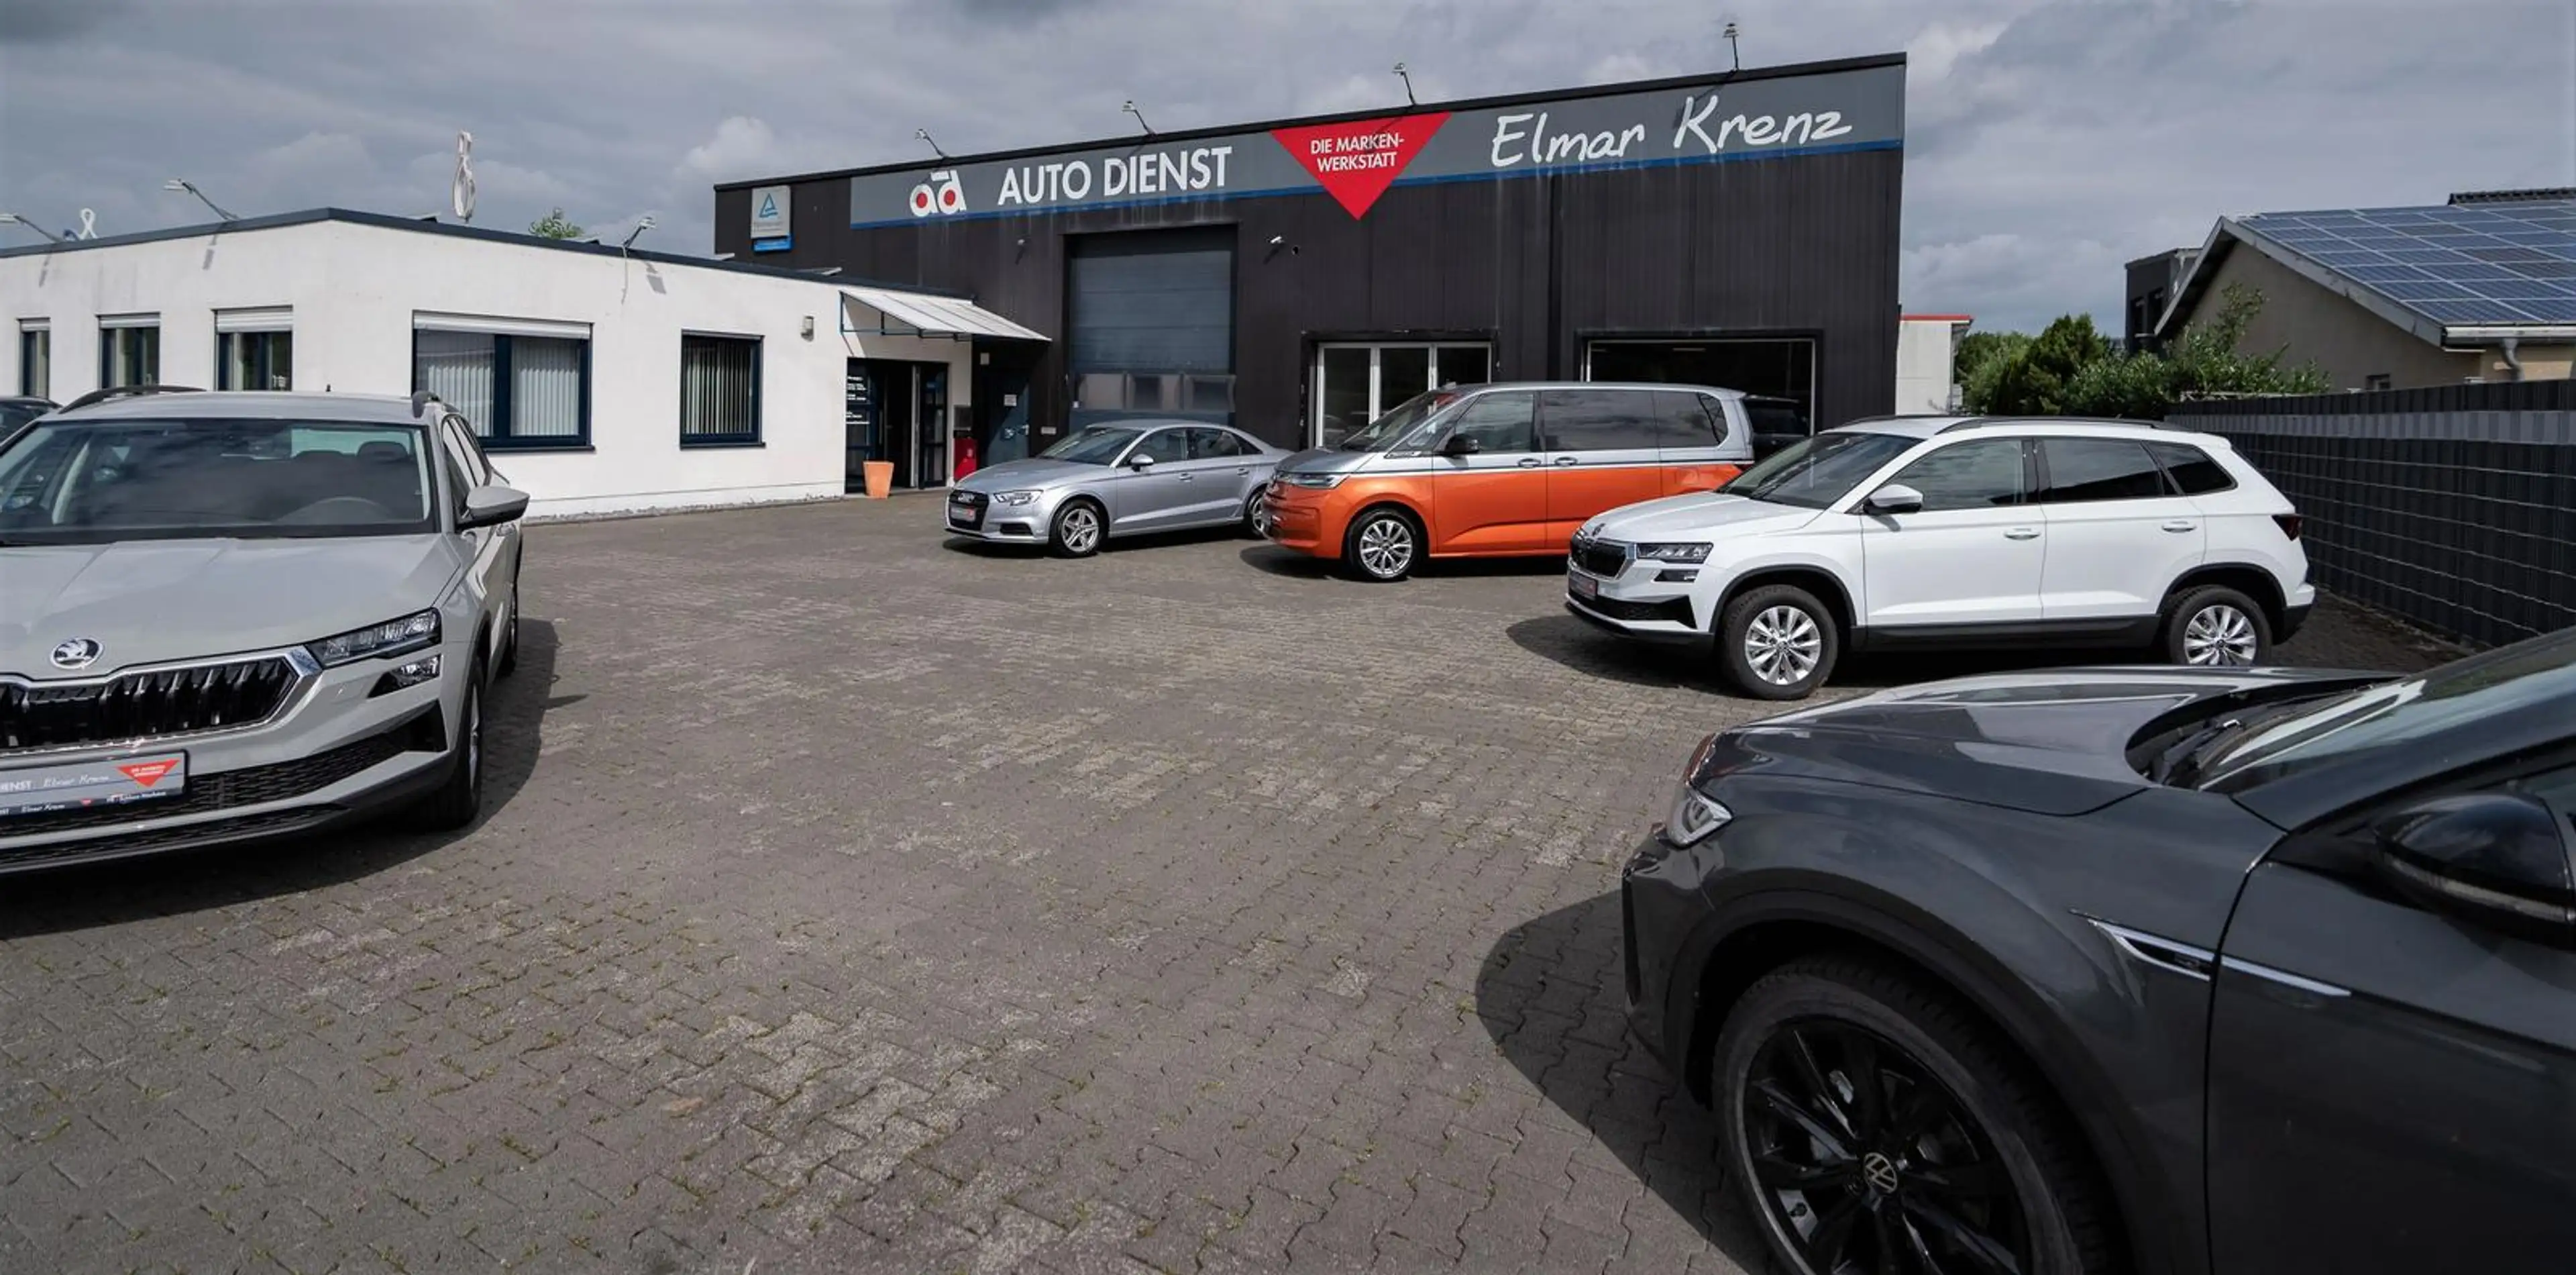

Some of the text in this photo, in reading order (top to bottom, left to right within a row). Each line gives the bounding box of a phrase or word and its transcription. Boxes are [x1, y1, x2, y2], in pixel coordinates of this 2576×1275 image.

[1311, 133, 1405, 154] DIE MARKEN-
[1491, 95, 1852, 167] Elmar Krenz
[998, 147, 1233, 206] AUTO DIENST
[1317, 152, 1397, 172] WERKSTATT
